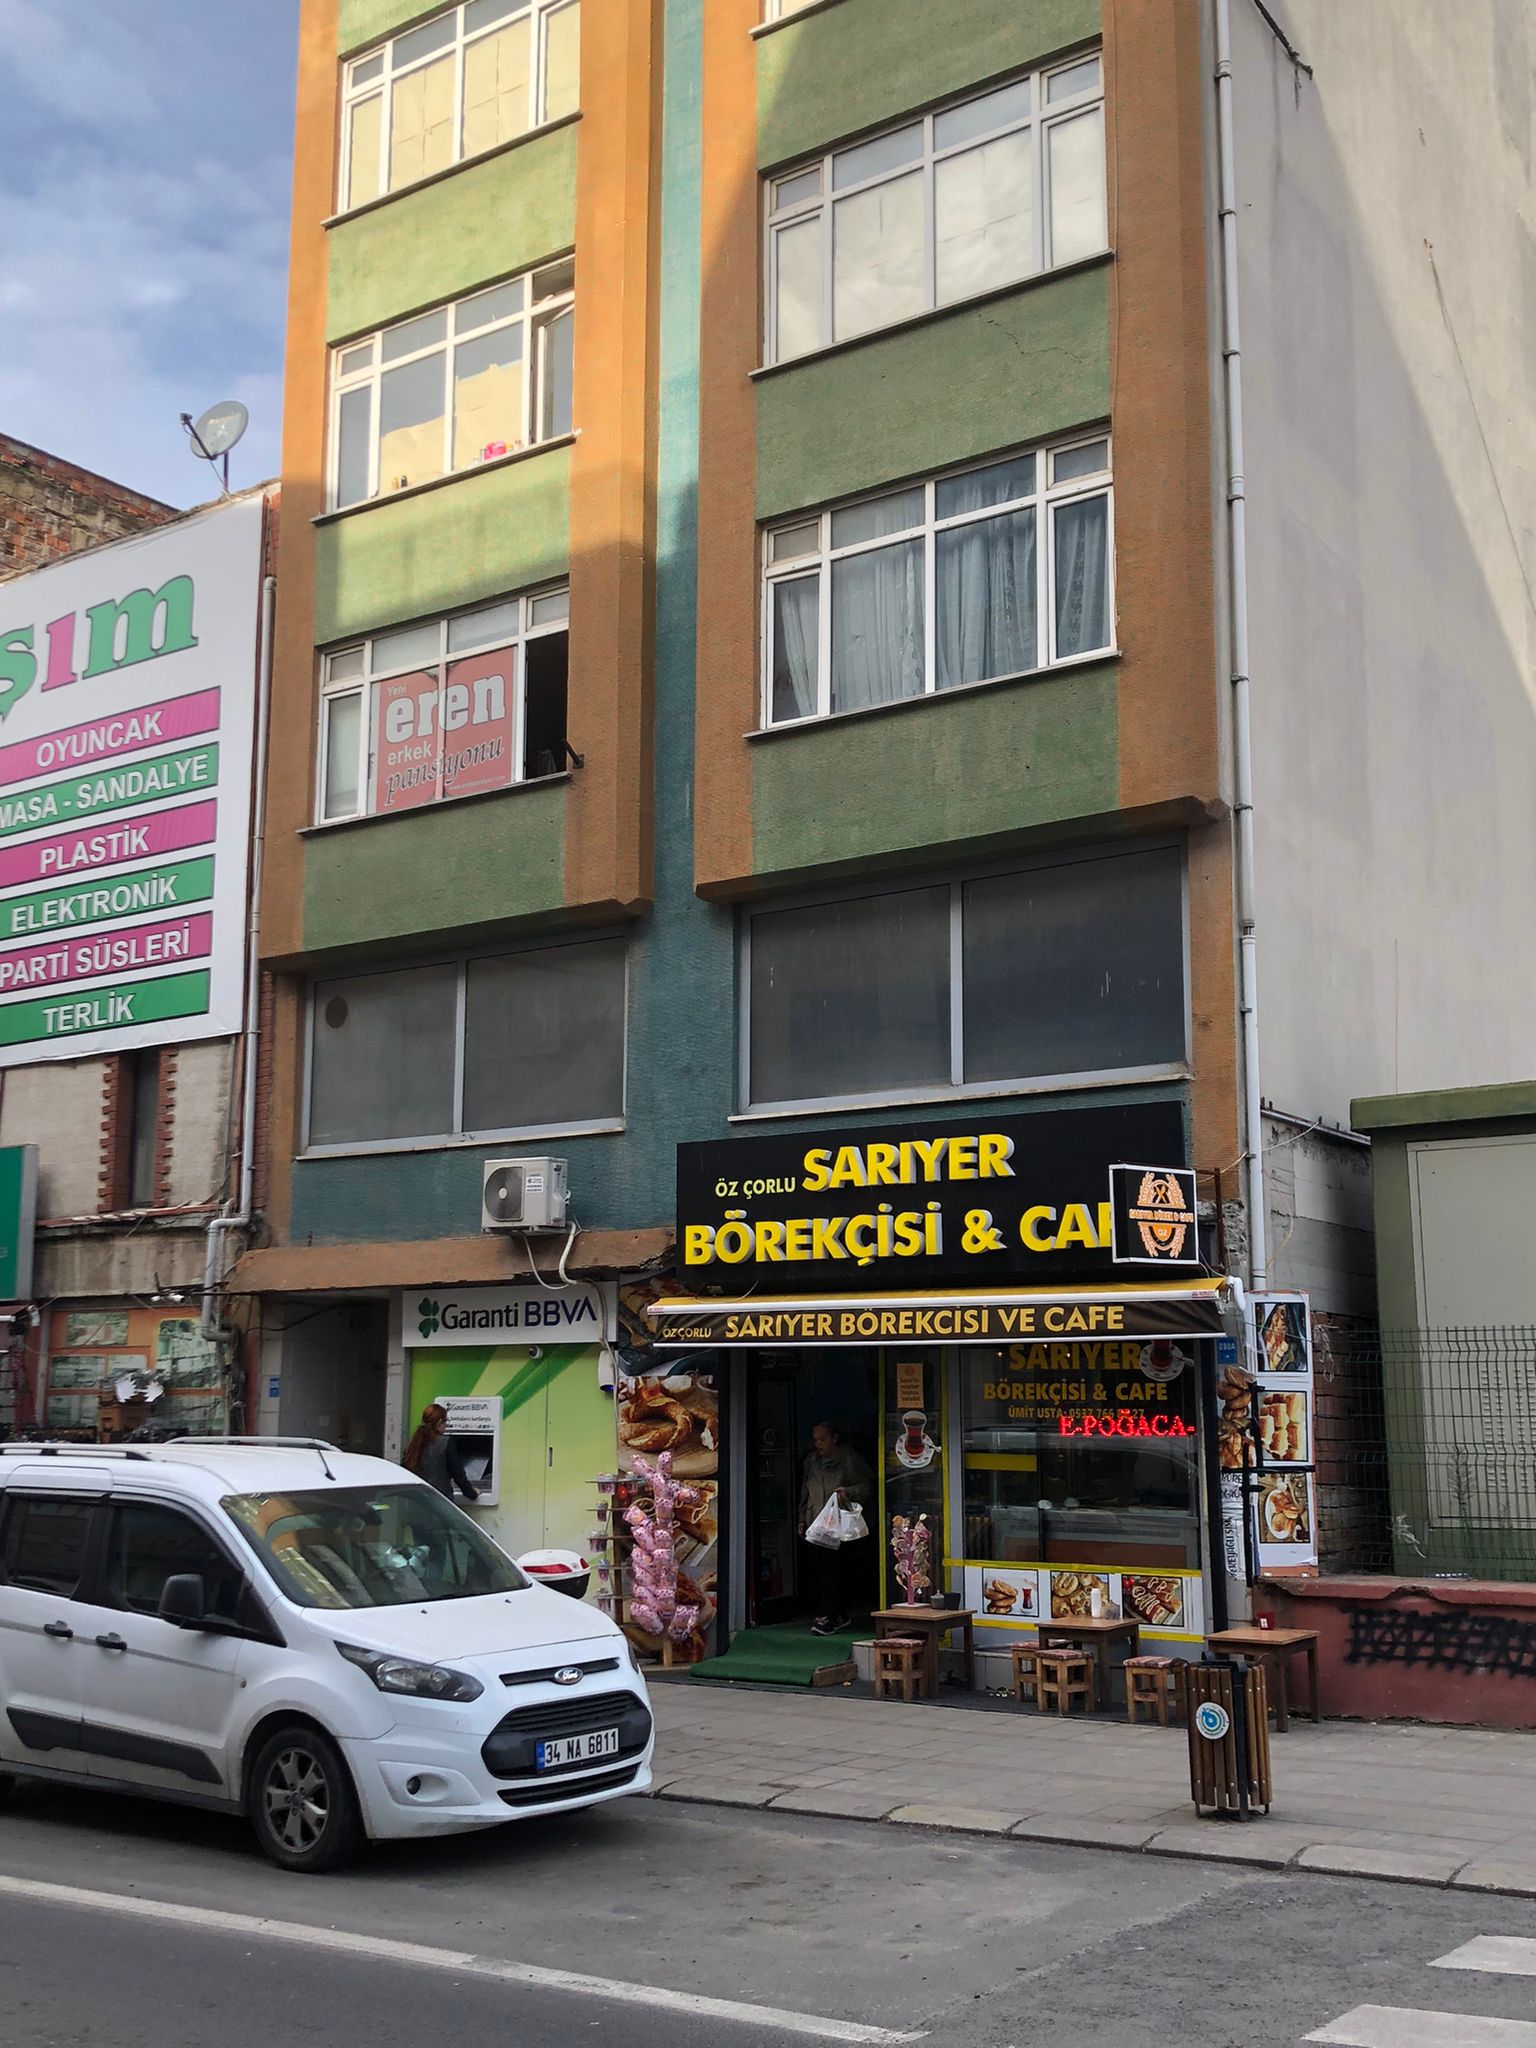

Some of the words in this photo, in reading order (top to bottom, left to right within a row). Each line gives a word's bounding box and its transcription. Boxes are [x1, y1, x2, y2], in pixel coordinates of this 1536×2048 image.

[385, 673, 506, 744] eren
[387, 686, 407, 697] Yeni
[37, 710, 163, 768] OYUNCAK
[387, 740, 432, 766] erkek
[0, 793, 58, 829] MASA
[77, 753, 209, 809] SANDALYE
[384, 736, 504, 807] pansiyonu
[40, 825, 151, 874] PLASTİK
[11, 872, 179, 933] ELEKTRONİK
[0, 945, 69, 988] PARTİ
[75, 921, 191, 974] SÜSLERİ
[42, 991, 135, 1033] TERLİK
[715, 1177, 739, 1198] ÖZ
[743, 1176, 796, 1200] ÇORLU
[802, 1134, 1016, 1192] SARIYER
[685, 1201, 944, 1267] BÖREKÇİSİ
[961, 1208, 1008, 1254] &
[440, 1300, 519, 1329] Garanti
[524, 1296, 597, 1327] BBVA
[725, 1313, 833, 1339] SARIYER
[998, 1308, 1035, 1333] VE
[1044, 1305, 1124, 1332] CAFE
[1009, 1343, 1141, 1370] SARIYER
[984, 1378, 1085, 1405] BÖREKÇİSİ
[1093, 1383, 1107, 1400] &
[1115, 1382, 1168, 1400] CAFE
[1008, 1404, 1034, 1418] ÜMİT
[546, 1743, 560, 1764] 34
[567, 1738, 581, 1760] NA
[588, 1730, 616, 1755] 6811
